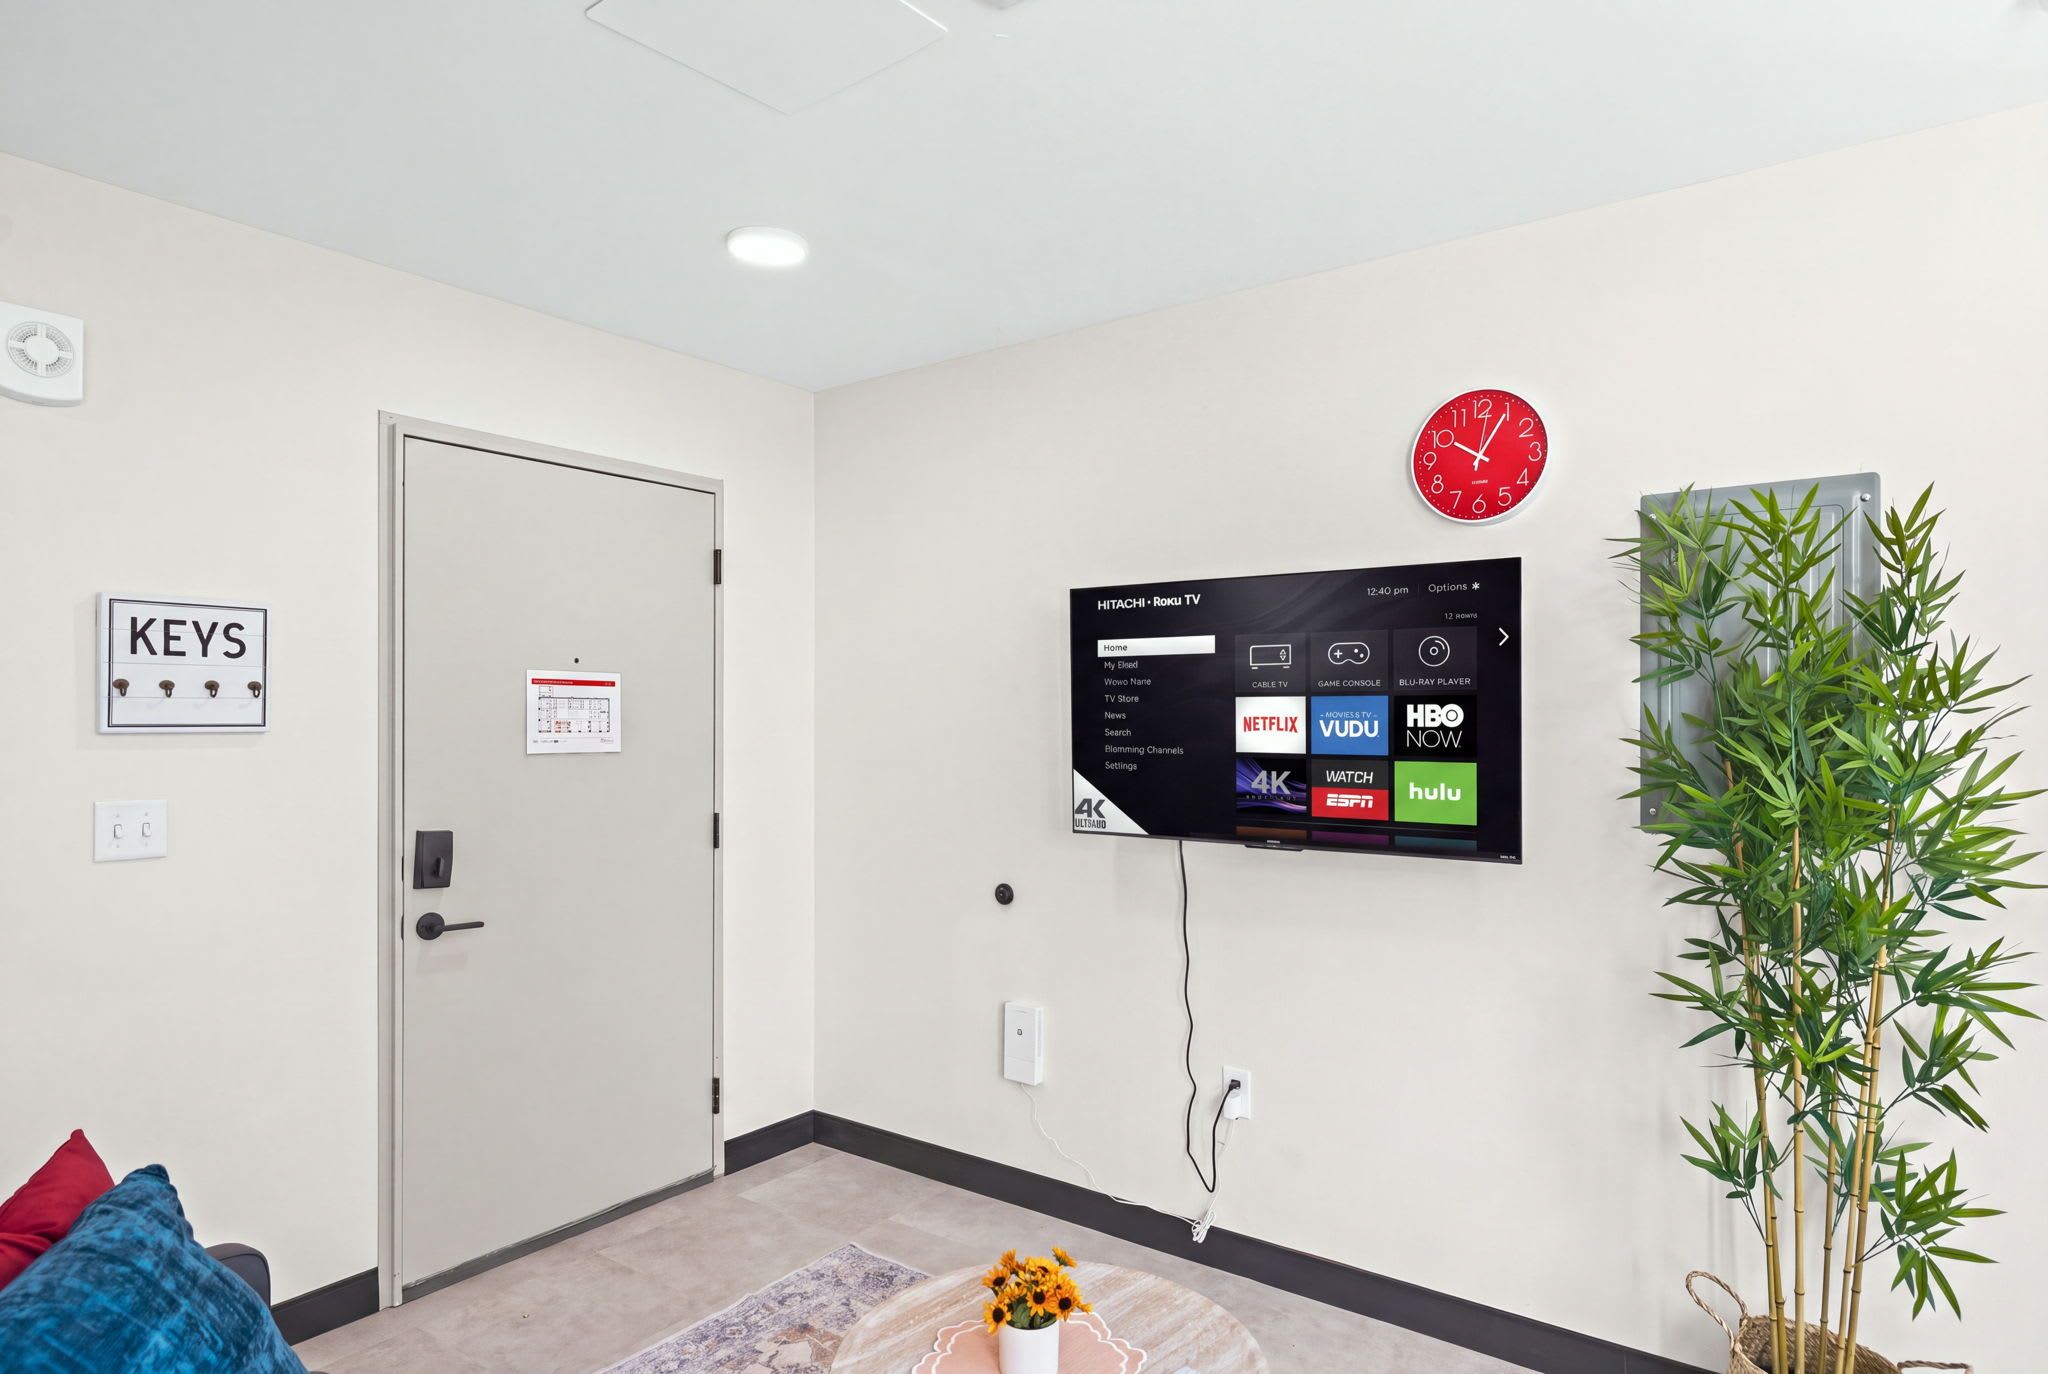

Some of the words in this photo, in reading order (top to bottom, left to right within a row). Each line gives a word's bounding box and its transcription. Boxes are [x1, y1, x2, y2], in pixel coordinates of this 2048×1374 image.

[1472, 399, 1493, 419] 12
[1504, 402, 1510, 421] 1
[1451, 409, 1466, 428] 11
[1518, 417, 1534, 438] 2
[1432, 429, 1455, 449] 10
[1528, 441, 1542, 462] 3
[1423, 451, 1437, 471] 9
[1431, 474, 1444, 494] 8
[1516, 468, 1530, 486] 4
[1449, 490, 1462, 509] 7
[1472, 493, 1486, 513] 6
[1497, 486, 1512, 506] 5
[1367, 587, 1391, 596] 12:40
[1393, 587, 1409, 596] pm
[1428, 583, 1468, 593] Options
[1097, 598, 1145, 610] HITACHI
[1153, 596, 1182, 607] Roku
[1184, 593, 1201, 605] TV
[130, 616, 247, 659] KEYS
[1103, 644, 1128, 652] Home
[1104, 661, 1115, 670] My
[1342, 679, 1381, 687] CONSOLE
[1399, 678, 1436, 686] BLU-RAY
[1437, 677, 1471, 686] PLAYER
[1104, 694, 1116, 703] TV
[1117, 694, 1140, 703] Store
[1104, 711, 1127, 720] News
[1325, 711, 1354, 719] MOVIES
[1361, 711, 1372, 719] TV
[1406, 703, 1465, 728] HBO
[1104, 728, 1132, 737] Search
[1243, 716, 1298, 733] NETFLIX
[1319, 720, 1379, 738] VUDU
[1406, 729, 1463, 748] NOW
[1146, 745, 1184, 755] Channels
[1251, 770, 1291, 795] 4K
[1326, 770, 1373, 784] WATCH
[1409, 782, 1462, 801] hulu
[1074, 798, 1106, 819] 4K
[1326, 793, 1374, 809] ESPN
